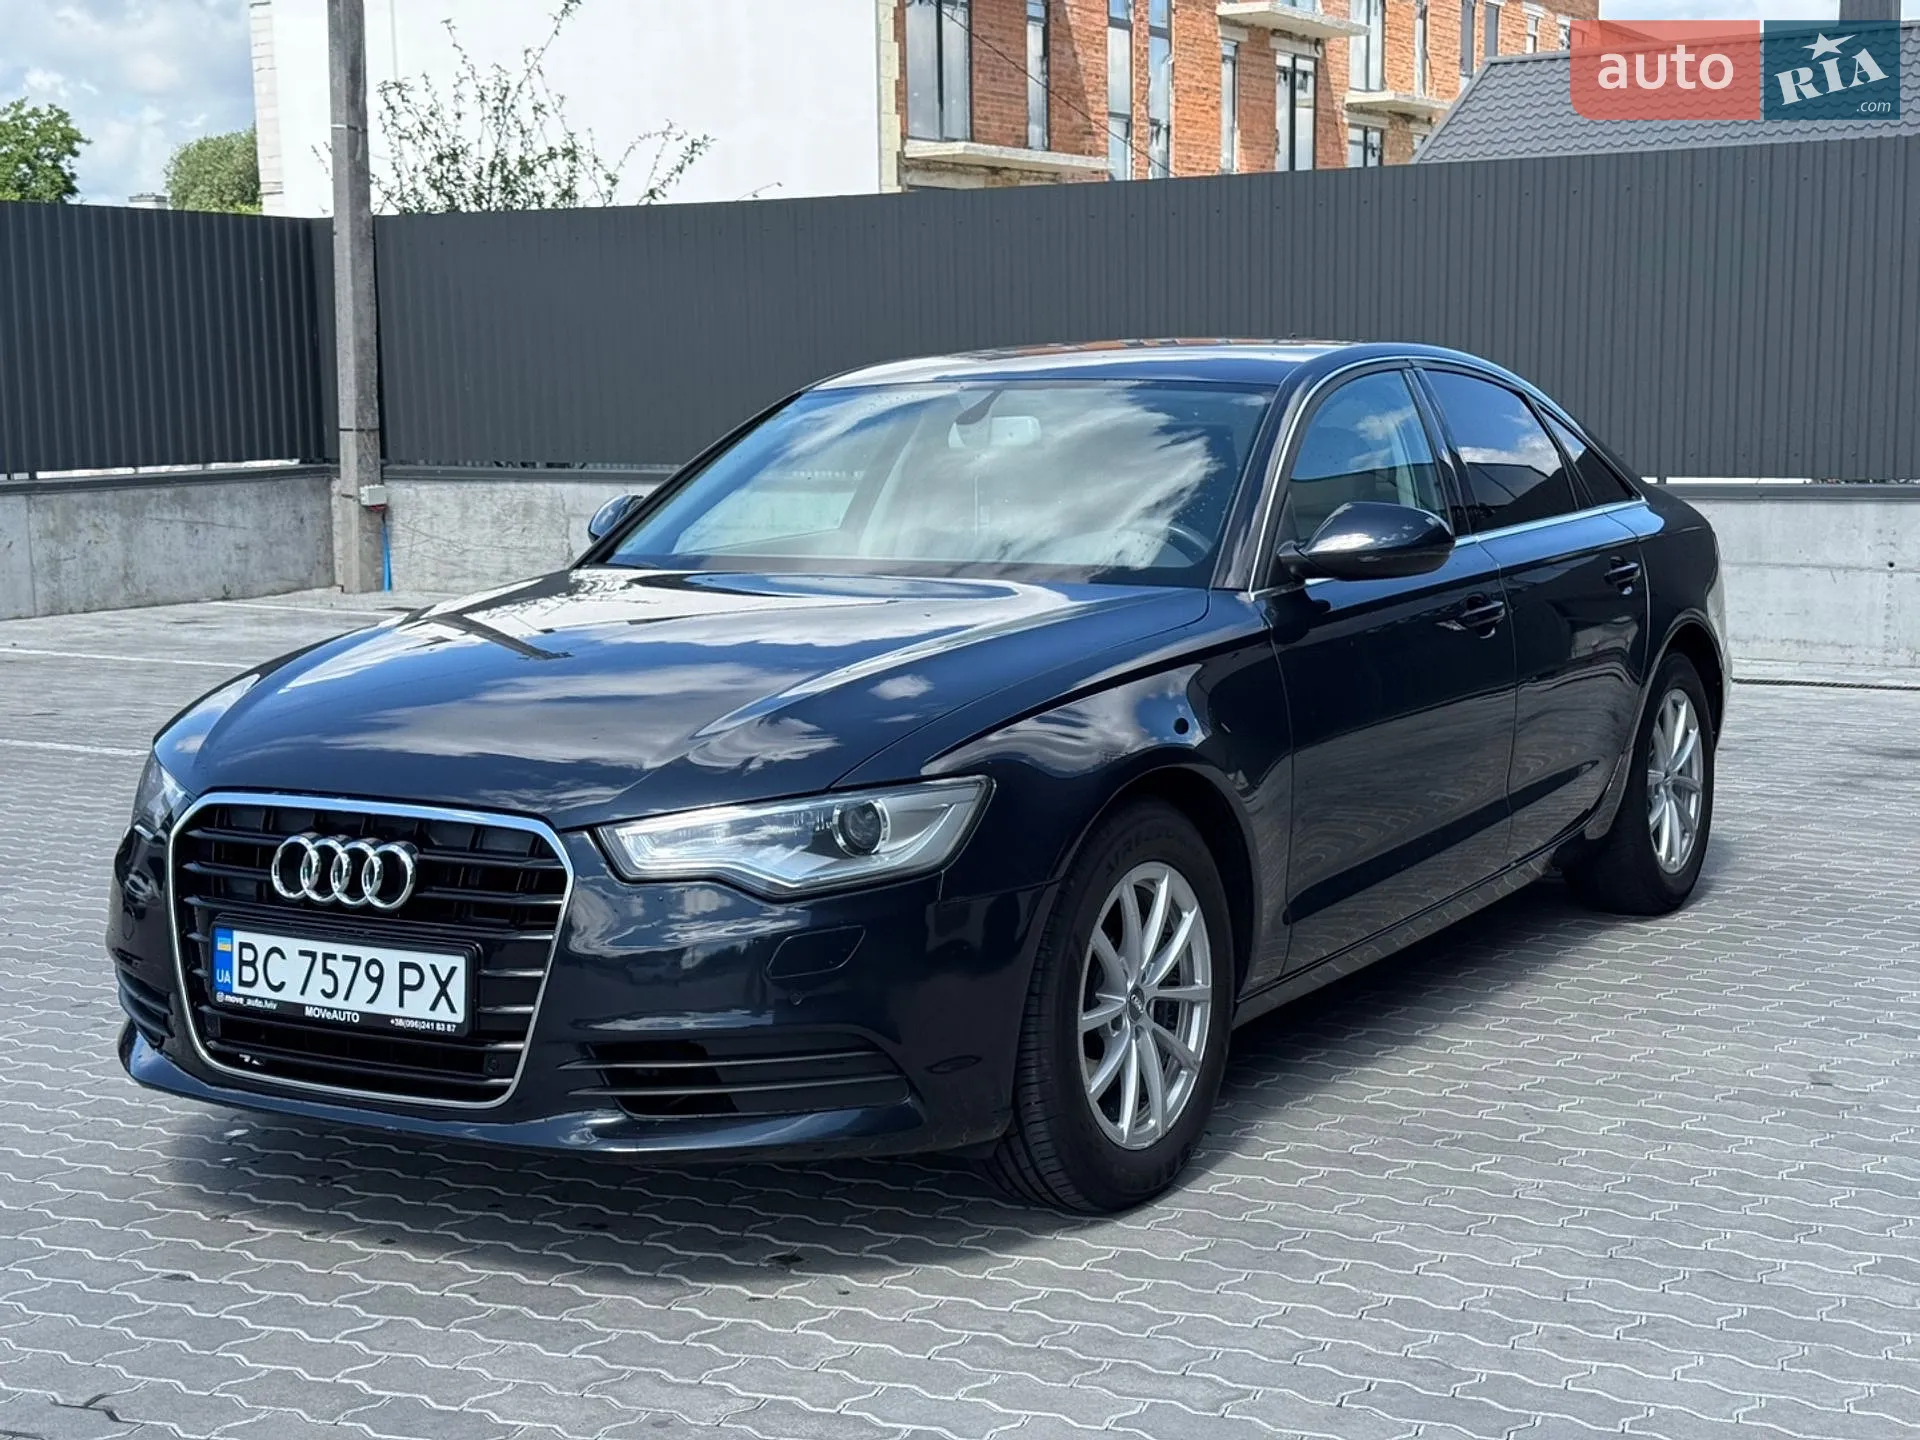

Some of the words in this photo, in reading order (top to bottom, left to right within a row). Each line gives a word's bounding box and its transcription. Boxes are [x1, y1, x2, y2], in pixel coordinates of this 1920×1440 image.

[216, 969, 231, 985] UA
[238, 941, 287, 993] BC
[298, 949, 384, 1005] 7579
[398, 961, 458, 1014] PX
[305, 1005, 360, 1023] MOVeAUTO
